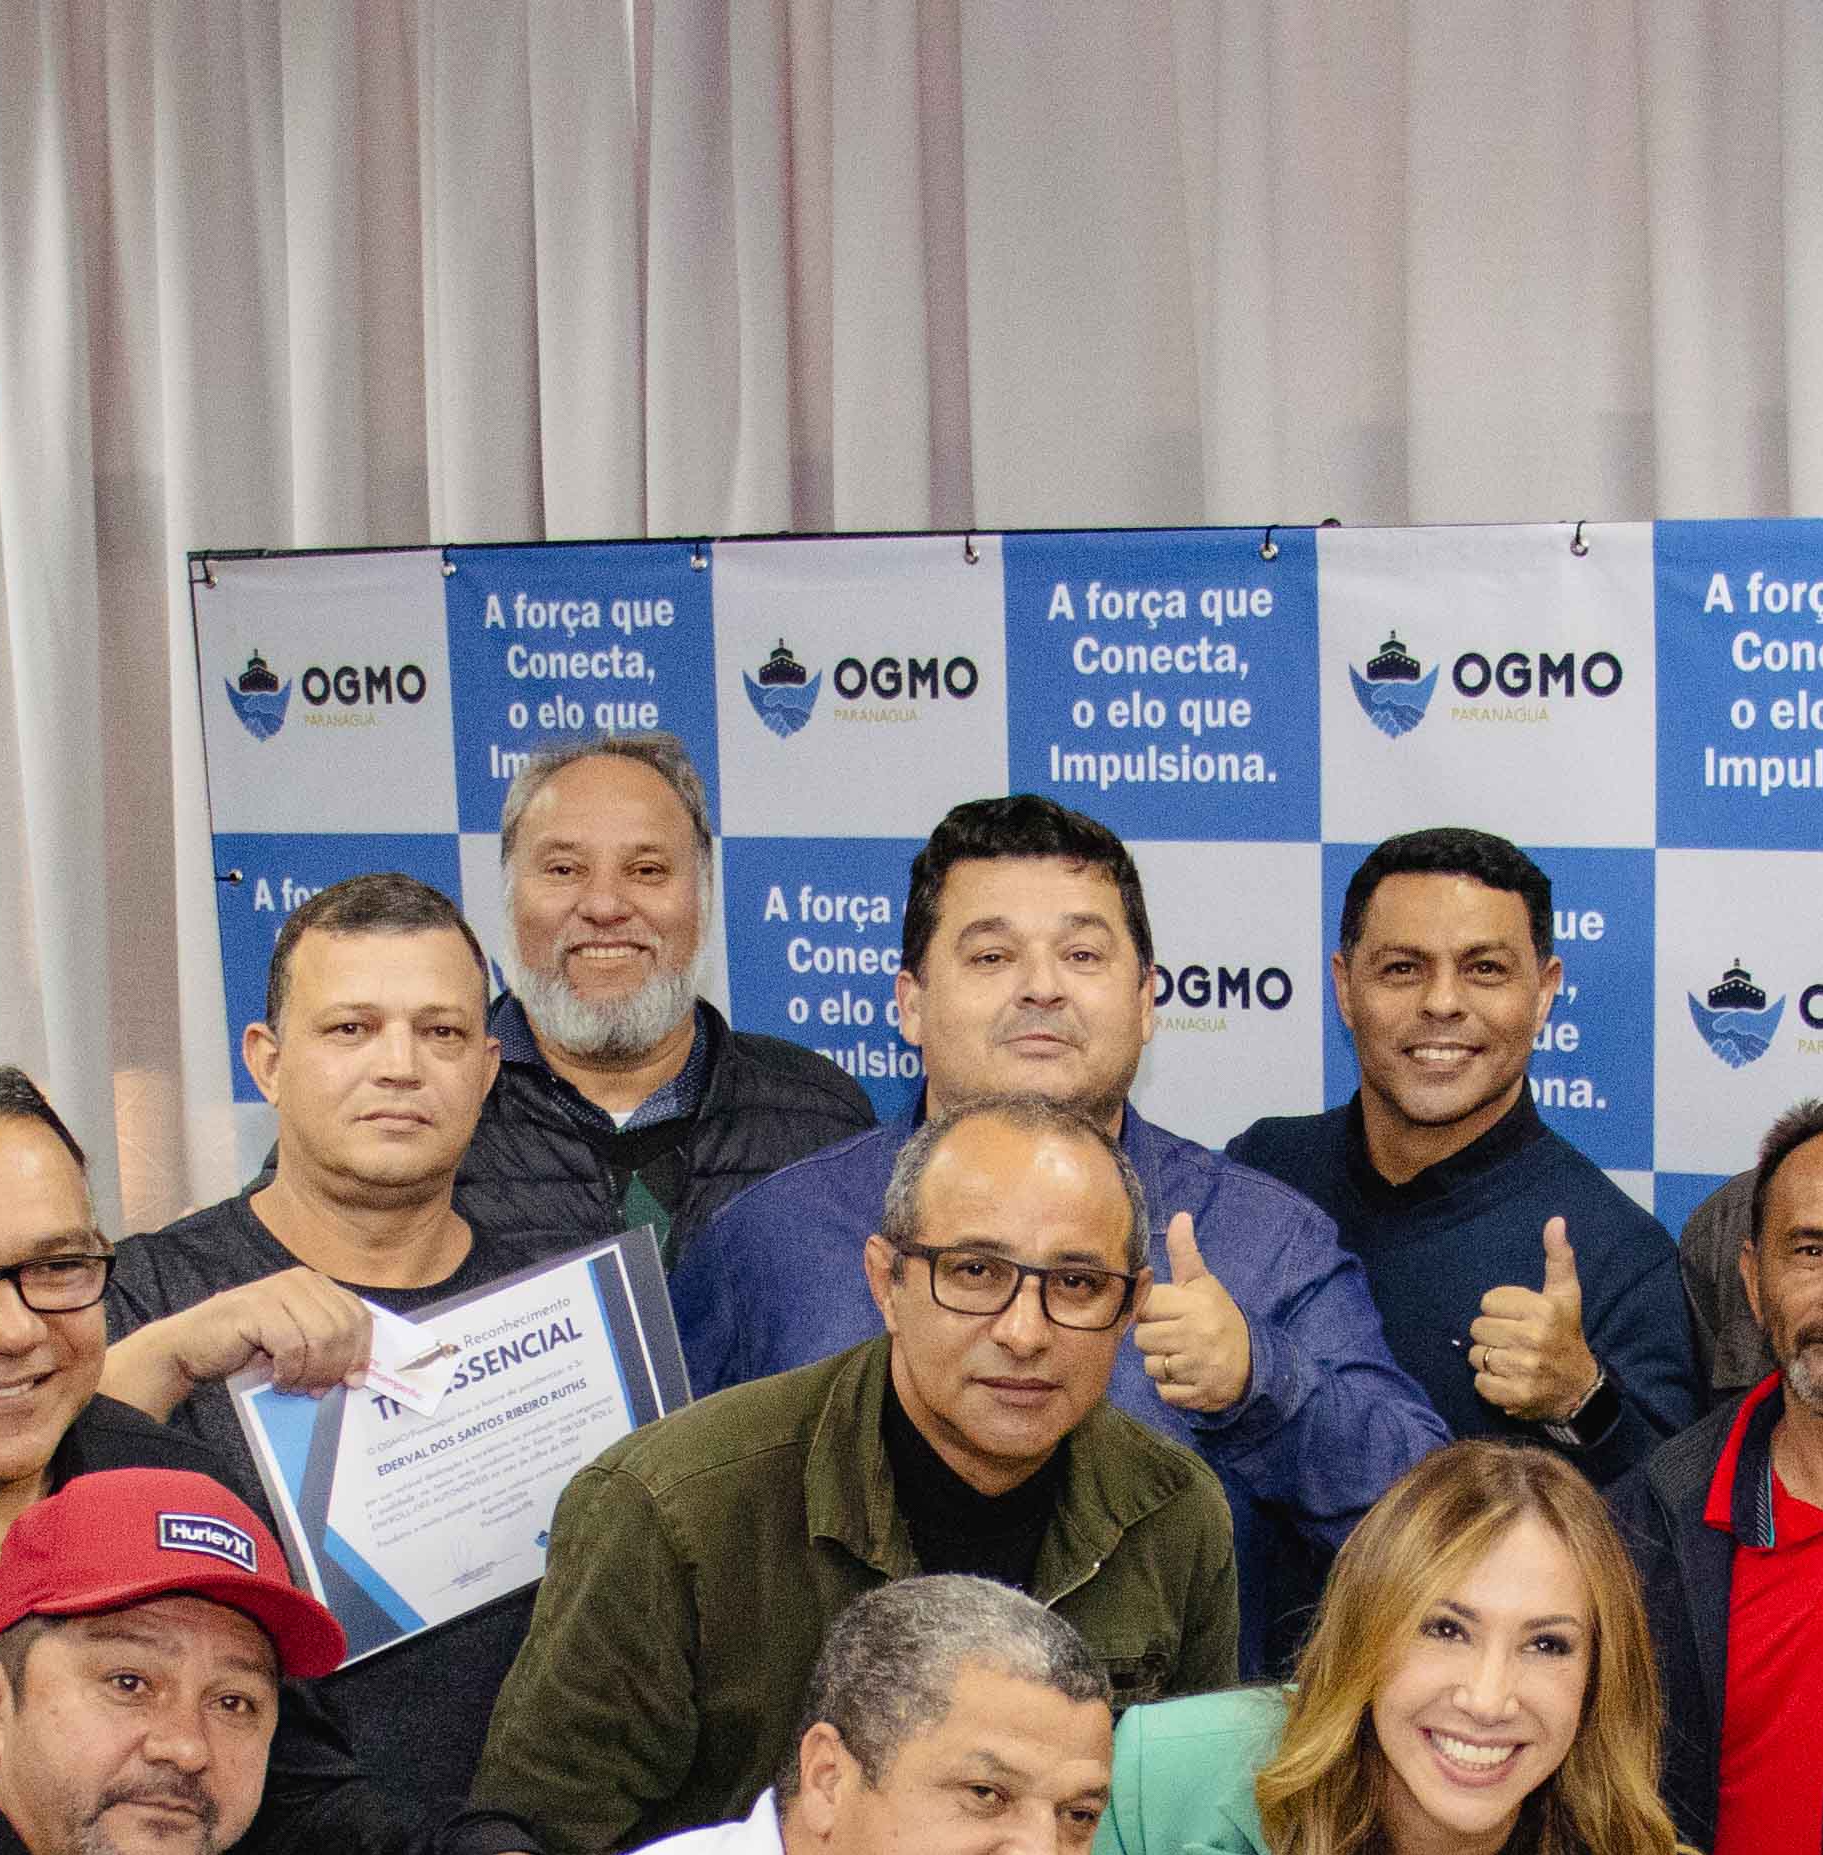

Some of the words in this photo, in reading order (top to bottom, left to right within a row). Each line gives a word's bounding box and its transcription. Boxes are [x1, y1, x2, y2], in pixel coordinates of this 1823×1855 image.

[1049, 583, 1074, 620] A
[1086, 582, 1186, 629] força
[1200, 587, 1273, 626] que
[1705, 573, 1734, 612] A
[485, 593, 505, 628] A
[513, 592, 600, 637] força
[611, 599, 674, 635] que
[507, 644, 655, 683] Conecta,
[834, 656, 978, 699] OGMO
[1073, 636, 1248, 678] Conecta,
[1453, 652, 1622, 697] OGMO
[302, 664, 426, 705] OGMO
[509, 702, 529, 729] o
[538, 694, 584, 729] elo
[595, 702, 658, 735] que
[1072, 700, 1095, 728] o
[1108, 690, 1166, 728] elo
[1179, 699, 1251, 736] que
[1731, 699, 1756, 729] o
[1051, 744, 1276, 790] Impulsiona.
[255, 879, 274, 910] A
[765, 885, 788, 920] A
[798, 885, 890, 933] força
[1555, 910, 1605, 941] ue
[786, 936, 902, 976] Conec
[788, 997, 809, 1023] o
[820, 989, 873, 1026] elo
[1535, 1021, 1580, 1052] ue
[464, 1296, 570, 1348] Reconhecimento
[444, 1317, 583, 1397] SSENCIAL
[378, 1447, 429, 1476] EDERVAL
[430, 1434, 455, 1456] DOS
[457, 1415, 504, 1443] SANTOS
[506, 1395, 549, 1421] RIBEIRO
[170, 1521, 233, 1551] Hurley
